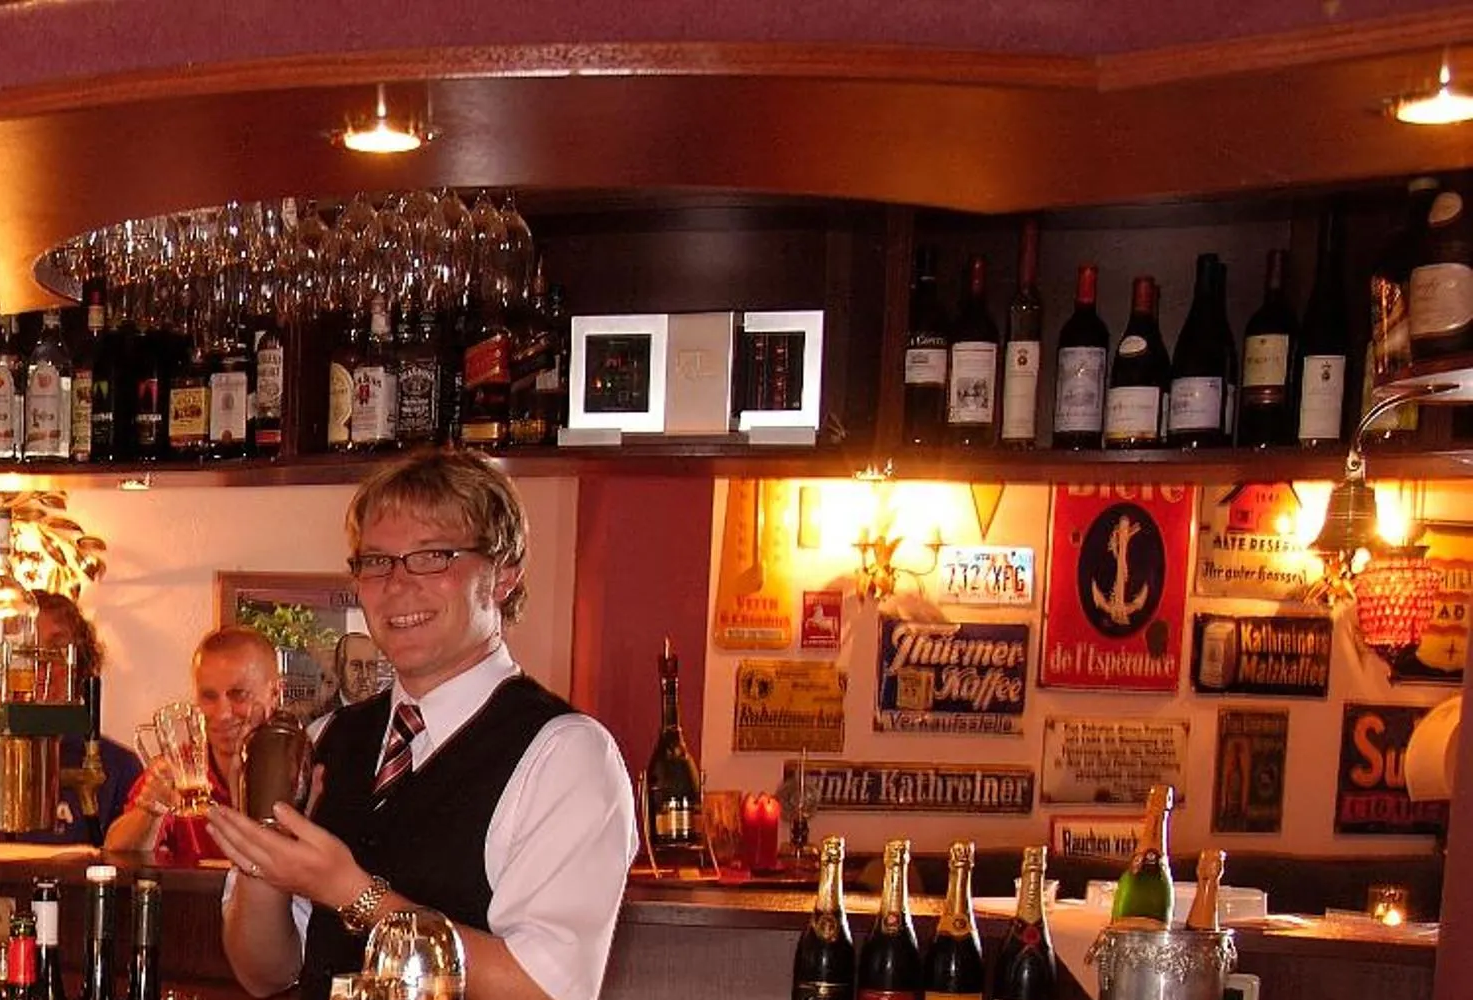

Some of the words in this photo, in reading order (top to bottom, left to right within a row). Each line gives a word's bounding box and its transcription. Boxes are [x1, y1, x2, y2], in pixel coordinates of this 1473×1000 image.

[1050, 642, 1072, 675] de
[934, 664, 1023, 711] Kaffee
[1351, 712, 1407, 789] Su
[880, 769, 1028, 806] Kathreiner
